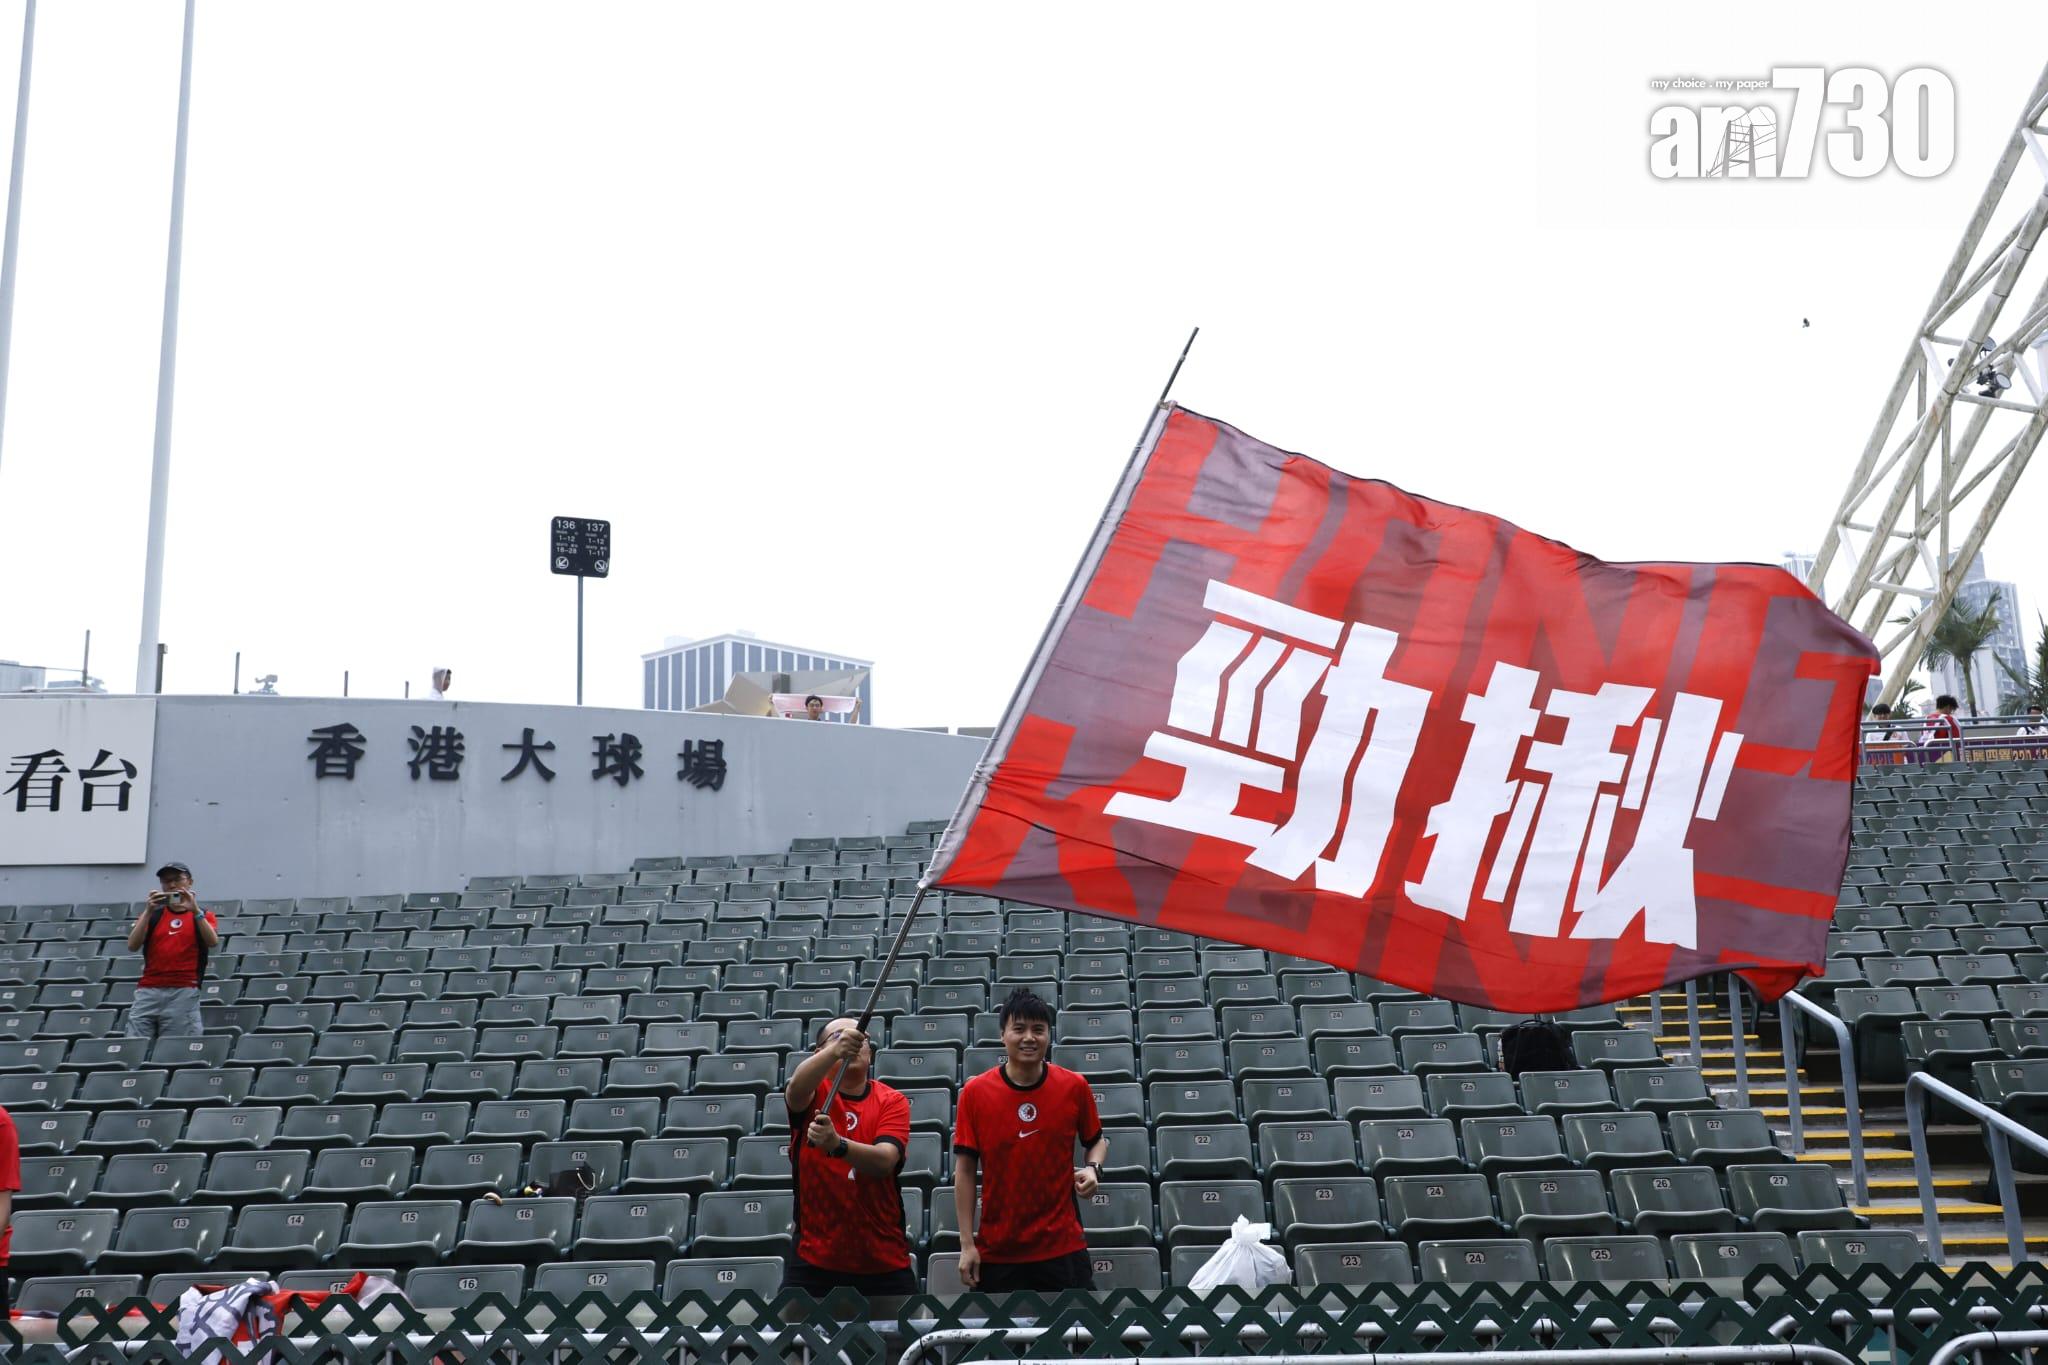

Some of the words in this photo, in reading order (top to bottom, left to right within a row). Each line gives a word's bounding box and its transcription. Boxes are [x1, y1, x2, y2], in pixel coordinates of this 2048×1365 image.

[557, 520, 576, 529] 136
[586, 523, 604, 532] 137
[306, 722, 728, 792] 香港大球場
[1102, 578, 1745, 951] 勁揪
[3, 748, 138, 812] 看台
[1655, 1179, 1668, 1188] 26
[1773, 1176, 1785, 1185] 27
[1430, 1187, 1441, 1196] 24
[1543, 1183, 1556, 1192] 25
[1095, 1195, 1106, 1203] 21
[1205, 1192, 1217, 1201] 22
[1318, 1190, 1330, 1199] 23
[633, 1207, 645, 1216] 17
[748, 1203, 759, 1211] 18
[404, 1213, 416, 1222] 15
[519, 1210, 530, 1218] 16
[175, 1219, 187, 1228] 13
[290, 1216, 302, 1225] 14
[60, 1222, 73, 1230] 12
[1850, 1244, 1862, 1253] 27
[1468, 1254, 1482, 1263] 24
[1594, 1250, 1608, 1259] 25
[1345, 1257, 1358, 1266] 23
[1097, 1262, 1109, 1271] 21
[591, 1275, 605, 1285] 17
[720, 1271, 733, 1281] 18
[462, 1279, 475, 1289] 16
